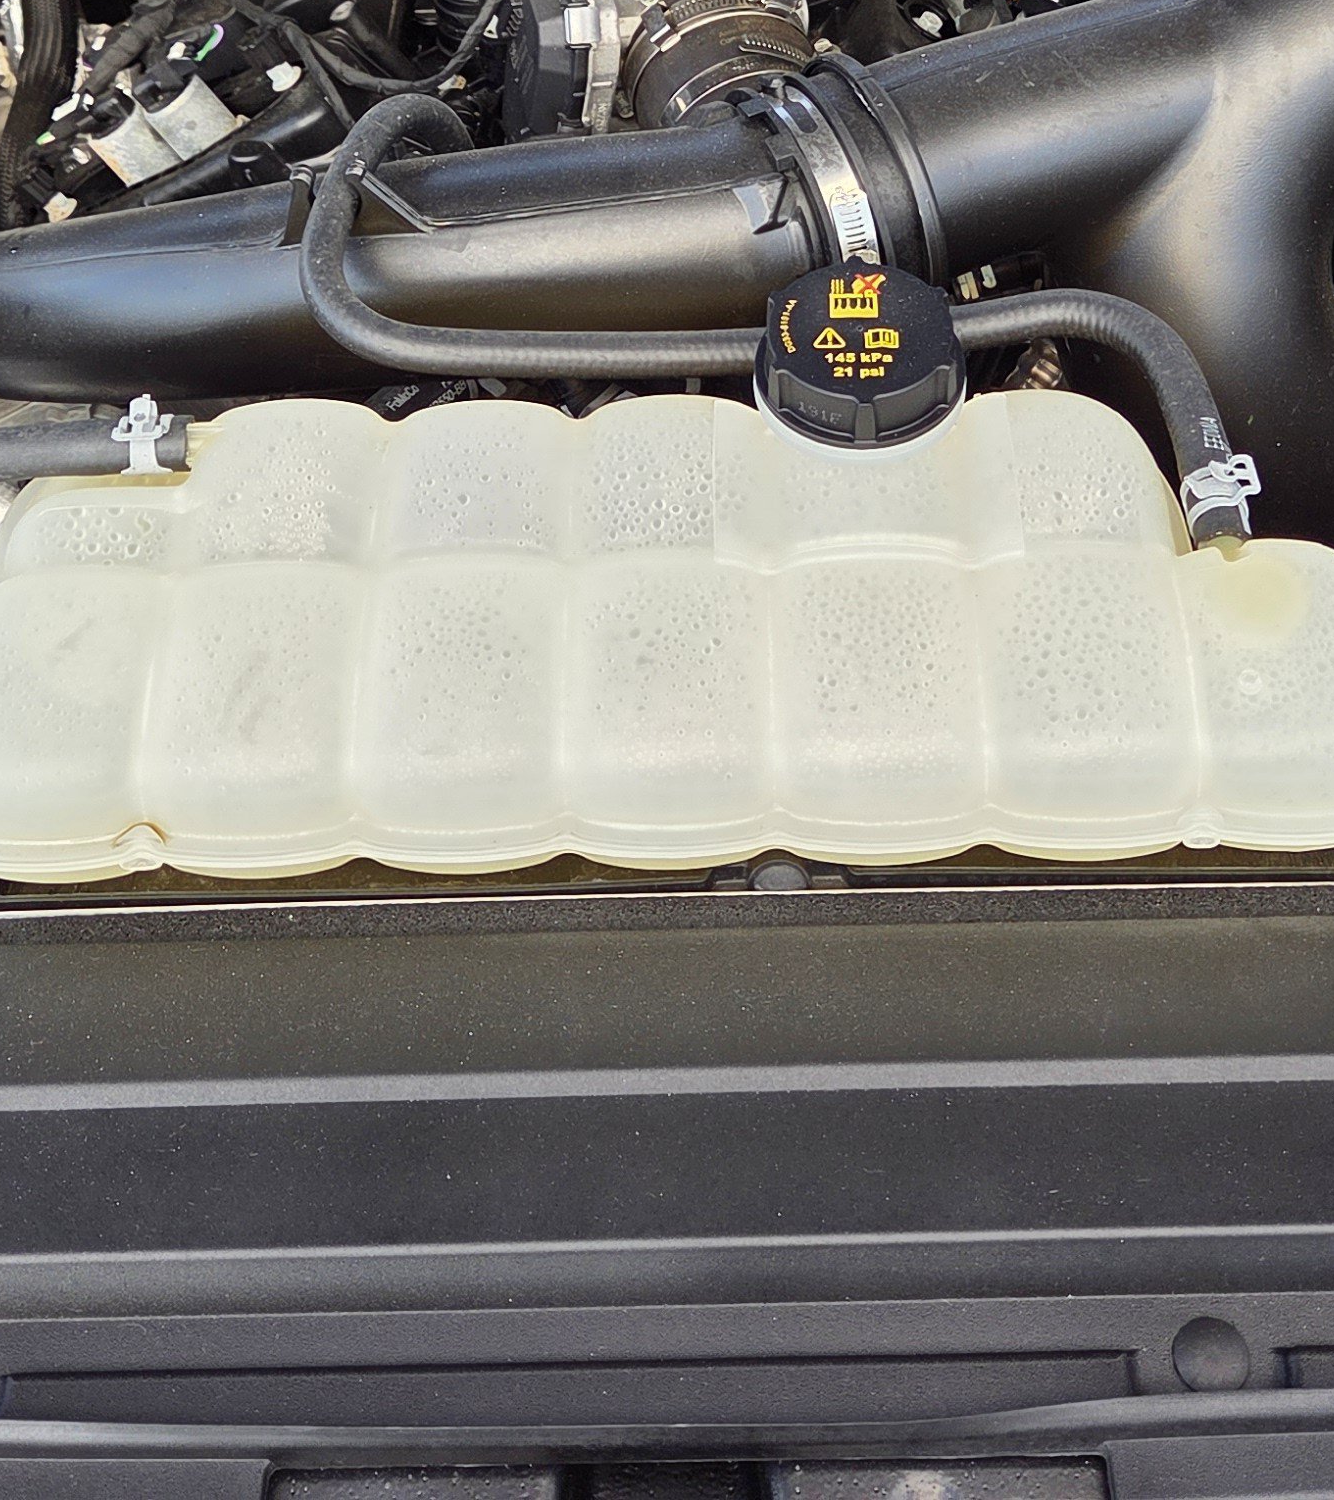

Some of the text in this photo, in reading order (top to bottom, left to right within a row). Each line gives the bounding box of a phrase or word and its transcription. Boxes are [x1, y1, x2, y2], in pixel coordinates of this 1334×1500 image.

[824, 352, 893, 363] 145 kPa
[833, 366, 885, 379] 21 psi
[385, 384, 421, 411] FoMoCo
